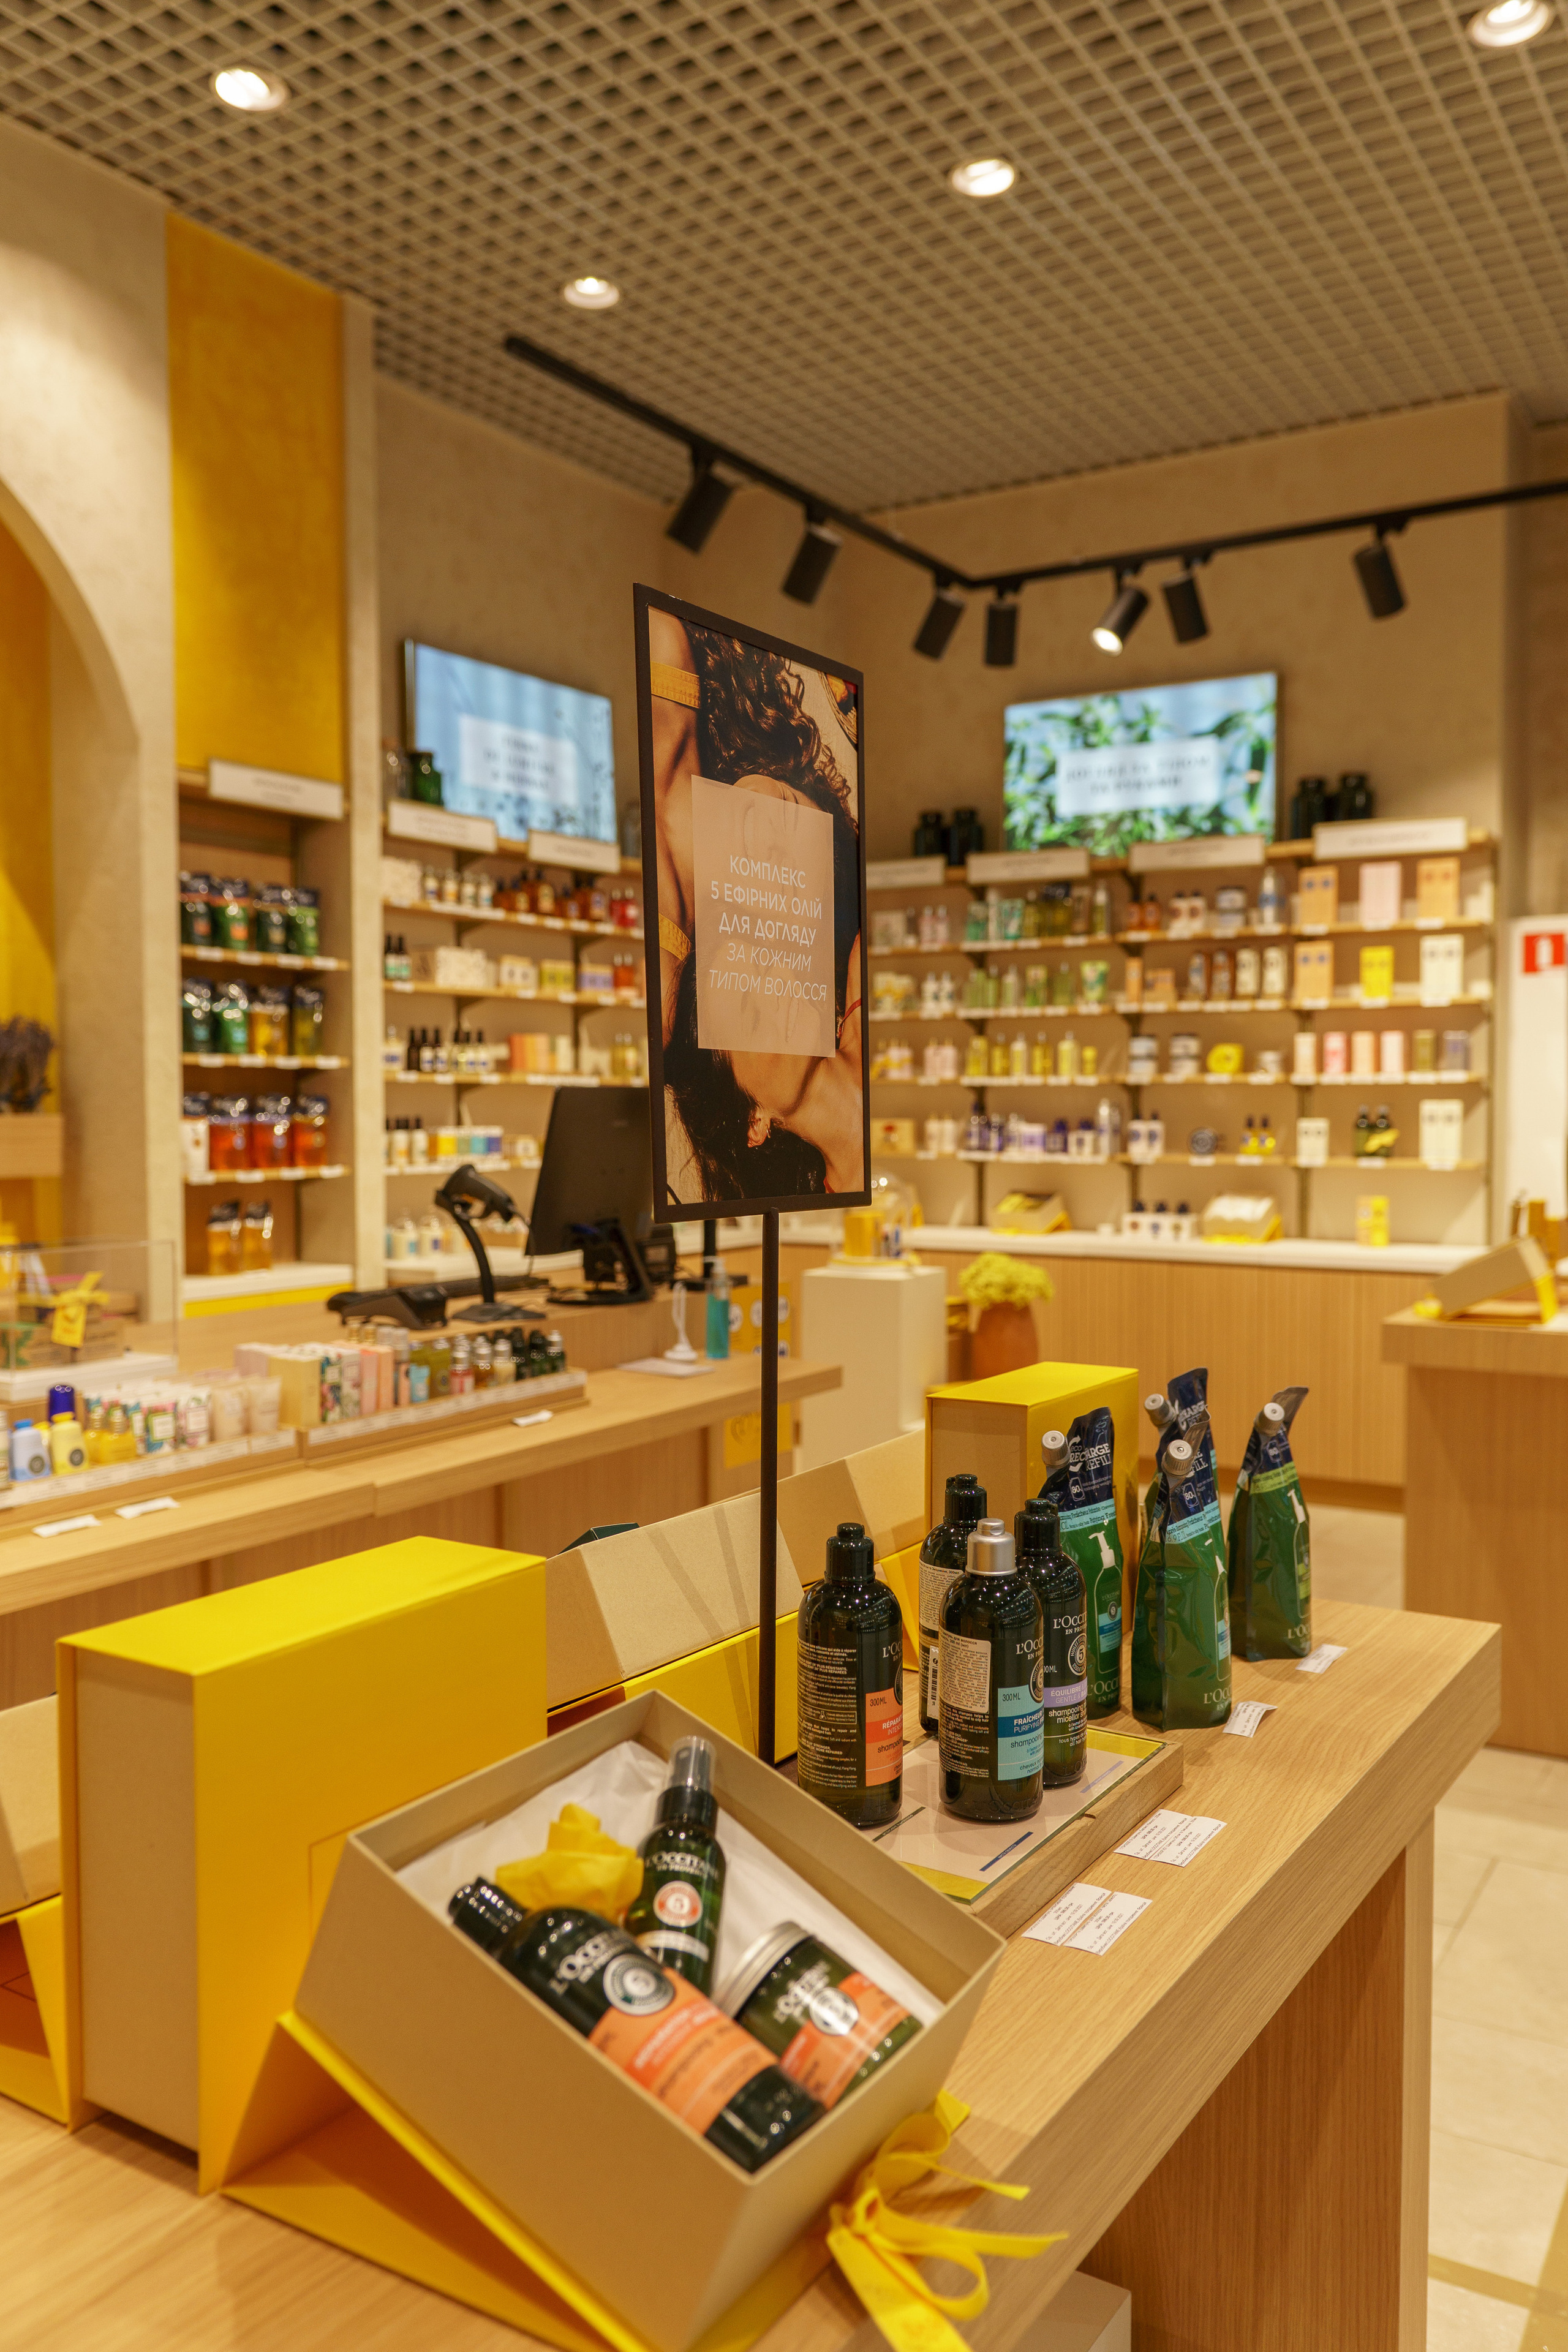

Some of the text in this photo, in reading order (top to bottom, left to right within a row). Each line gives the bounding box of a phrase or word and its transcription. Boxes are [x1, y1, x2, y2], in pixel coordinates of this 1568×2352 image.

[730, 855, 805, 888] КОМПЛЕКС
[711, 881, 821, 919] 5 ЕФІРНИХ ОЛІЙ
[719, 913, 816, 948] ДЛЯ ДОГЛЯДУ
[727, 943, 812, 971] ЗА КОЖНИМ
[709, 970, 827, 1001] ТИПОМ ВОЛОССЯ
[1079, 1648, 1084, 1660] 5
[1002, 1692, 1020, 1702] 300ML
[1051, 1686, 1080, 1697] ÉQUILIBRE
[870, 1697, 887, 1706] 300ML
[1056, 1694, 1076, 1703] GENTLE
[1049, 1705, 1083, 1717] shampooing
[1057, 1713, 1079, 1724] micellar
[1014, 1720, 1040, 1733] PURIFYING
